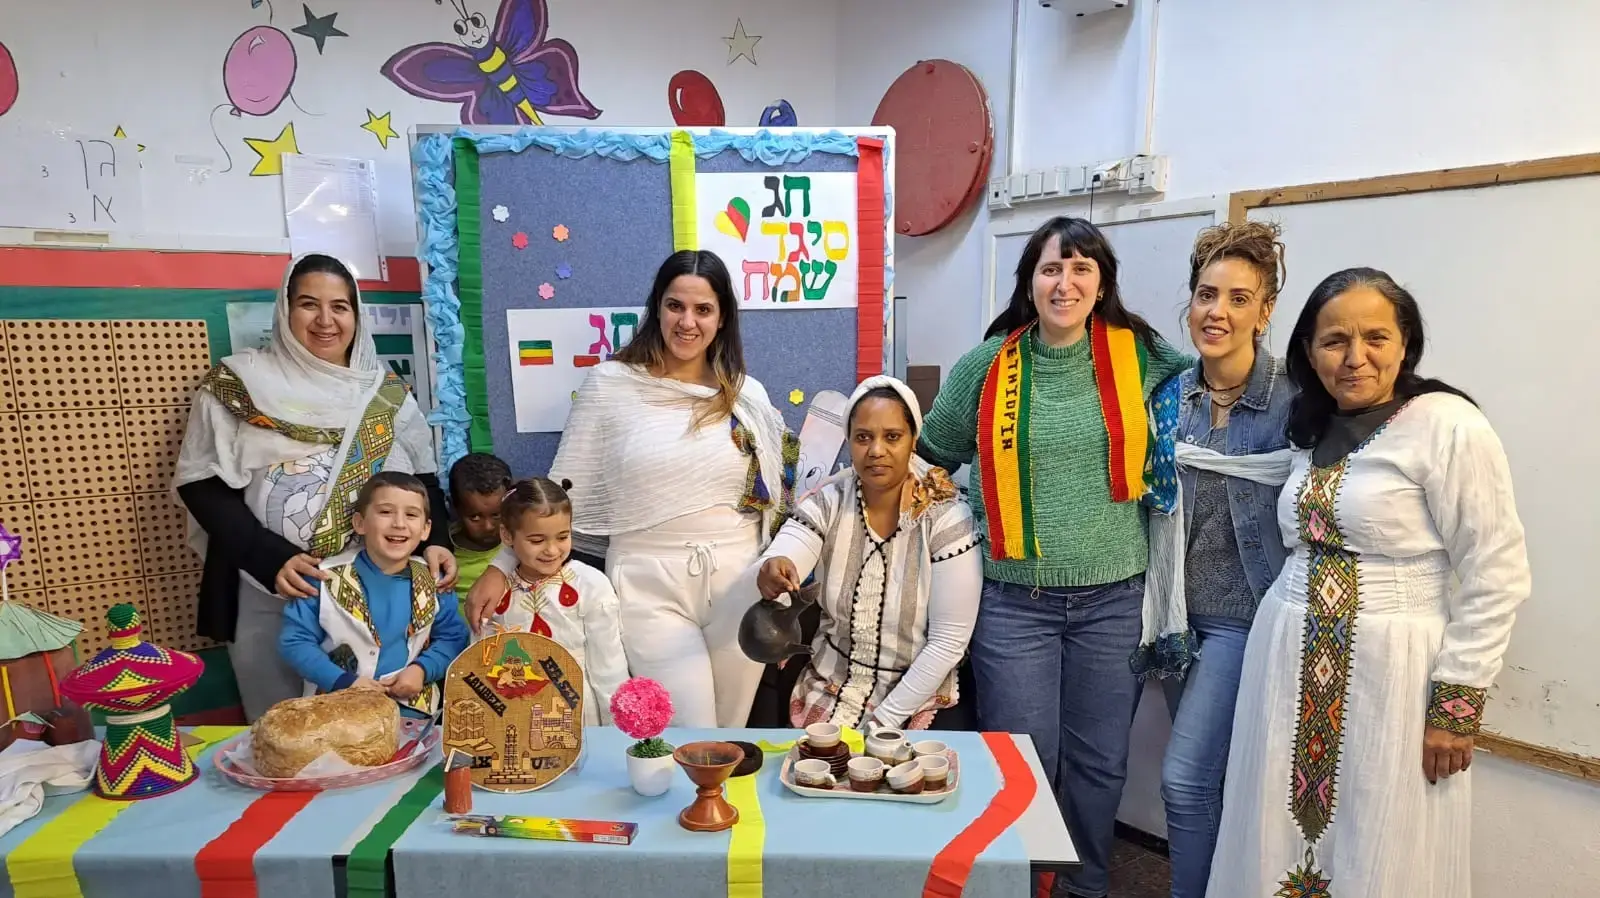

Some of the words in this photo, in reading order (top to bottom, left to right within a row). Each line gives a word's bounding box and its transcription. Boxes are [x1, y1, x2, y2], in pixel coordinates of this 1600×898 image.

[762, 174, 811, 218] חג
[760, 219, 850, 262] סיגד
[741, 259, 838, 303] שמח
[588, 312, 639, 355] חג
[462, 671, 507, 719] LALIBELA
